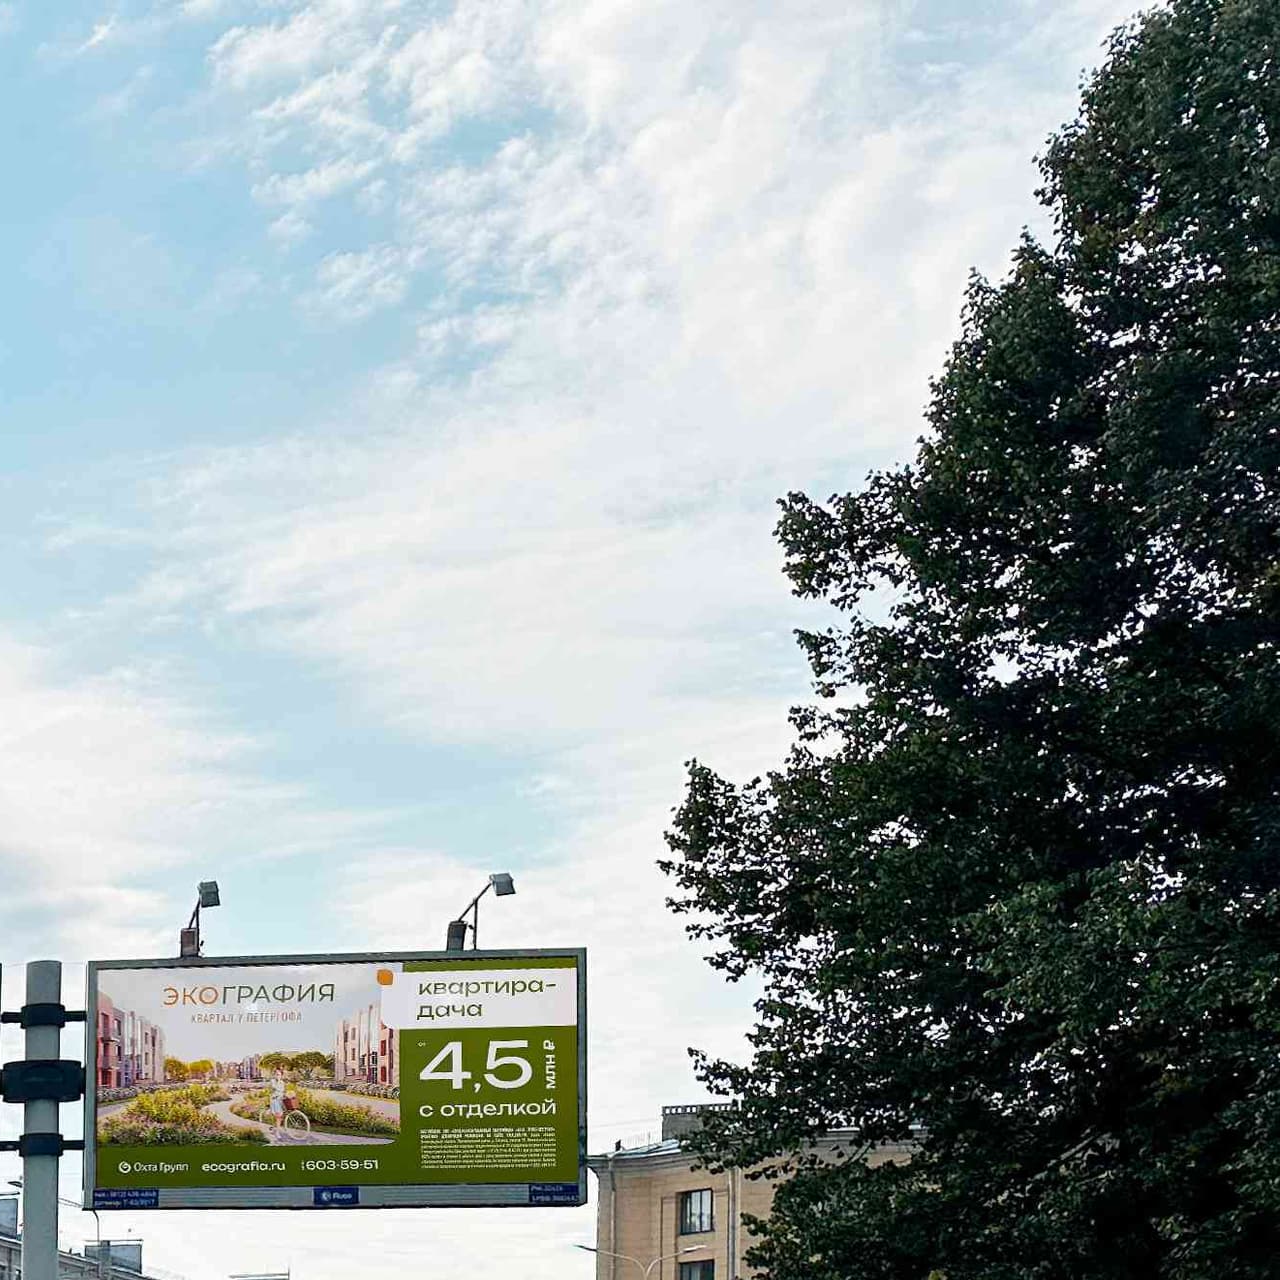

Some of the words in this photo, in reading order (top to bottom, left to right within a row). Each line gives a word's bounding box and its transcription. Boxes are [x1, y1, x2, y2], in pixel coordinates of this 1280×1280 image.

[162, 983, 335, 1006] ЭКОГРАФИЯ
[418, 979, 556, 997] квартира-
[191, 1013, 234, 1023] КВАРТАЛ
[417, 1004, 482, 1020] дача
[419, 1040, 533, 1093] 4,5
[546, 1054, 556, 1089] млн
[419, 1105, 434, 1117] с
[440, 1098, 557, 1118] отделкой
[133, 1162, 158, 1172] Охта
[159, 1162, 189, 1173] Групп
[201, 1161, 286, 1173] ecografia.ru
